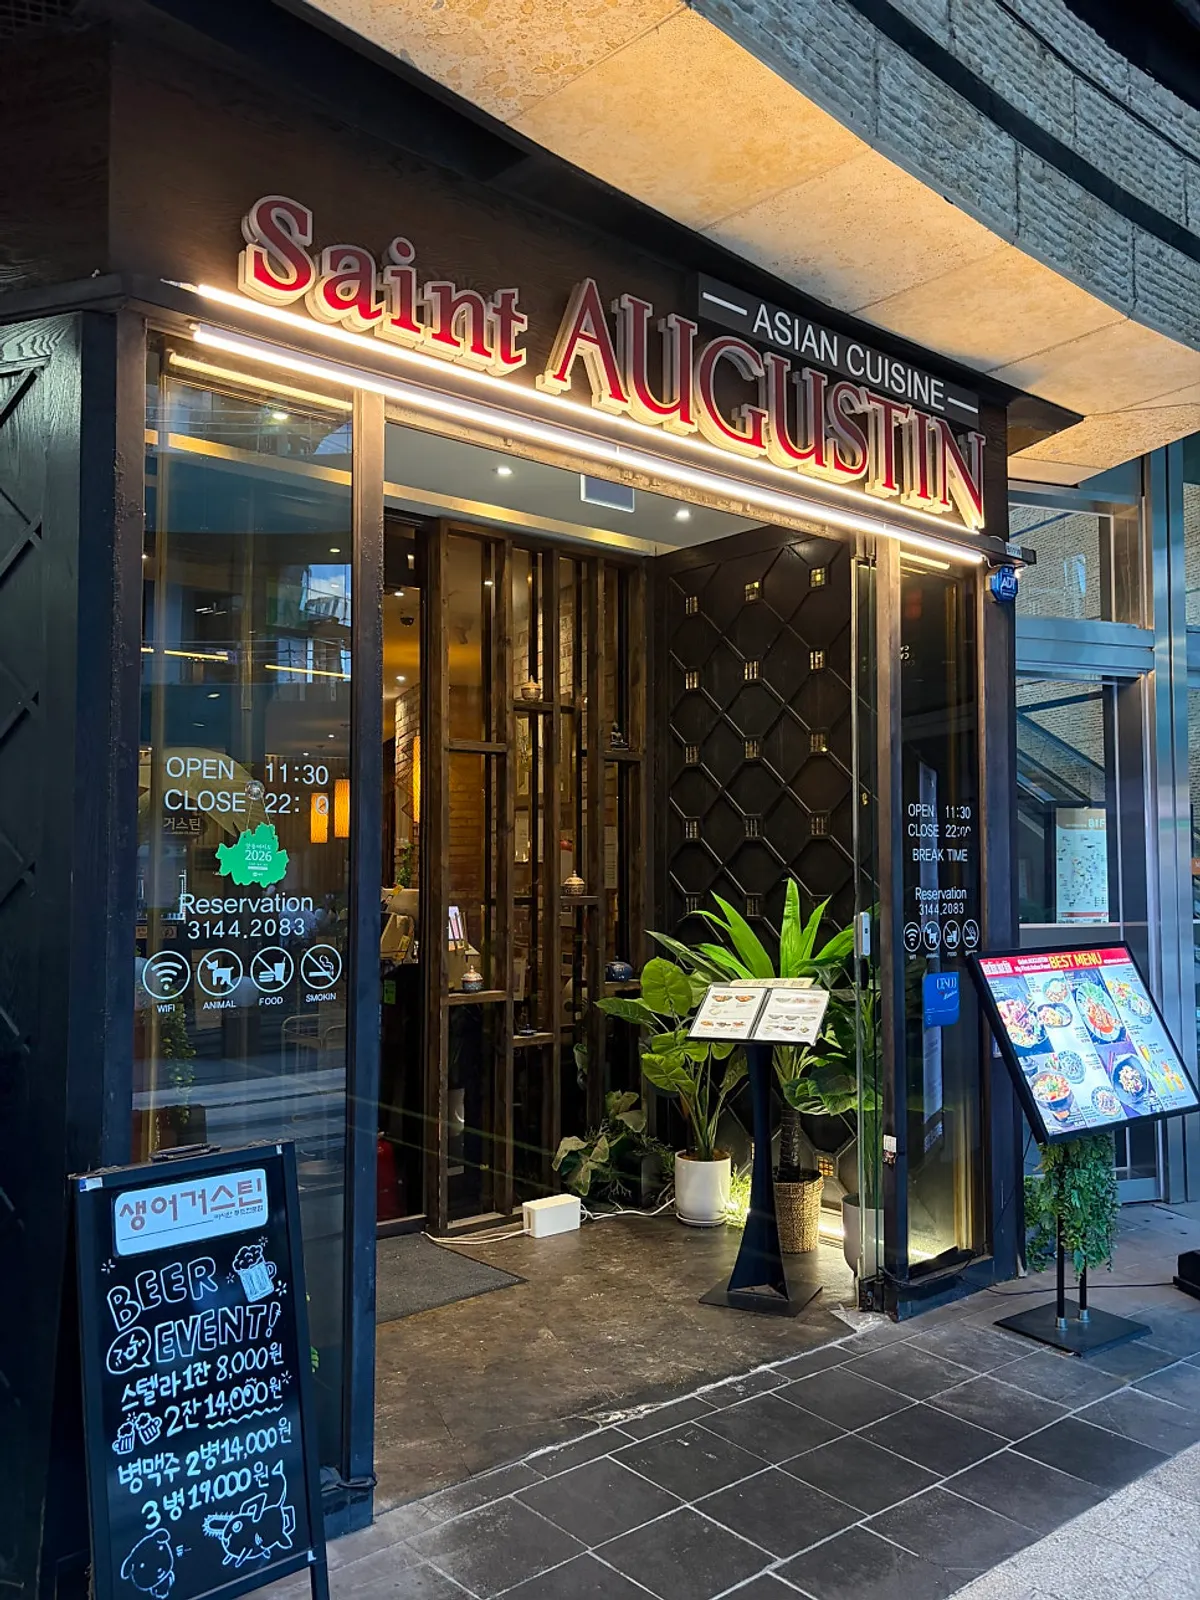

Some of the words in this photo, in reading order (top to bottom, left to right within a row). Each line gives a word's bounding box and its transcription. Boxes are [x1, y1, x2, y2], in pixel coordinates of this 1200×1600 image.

[238, 195, 528, 377] Saint
[536, 277, 986, 529] AUGUSTIN
[752, 303, 838, 367] ASIAN
[845, 343, 946, 411] CUISINE
[165, 756, 235, 781] OPEN
[265, 762, 329, 786] 11:30
[164, 788, 246, 813] CLOSE
[908, 803, 935, 818] OPEN
[945, 804, 972, 820] 11:30
[908, 823, 940, 838] CLOSE
[244, 849, 273, 862] 2026
[912, 848, 945, 862] BREAK
[946, 848, 969, 862] TIME
[179, 892, 314, 916] Reservation
[915, 886, 968, 901] Reservation
[919, 902, 965, 916] 3144.2083
[187, 917, 306, 940] 3144.2083
[1049, 953, 1075, 969] BEST
[1075, 951, 1103, 967] MENU
[157, 1003, 176, 1013] WIFI
[203, 1000, 237, 1010] ANIMAL
[258, 996, 284, 1006] FOOD
[119, 1177, 264, 1231] 생어거스틴
[106, 1256, 219, 1332] BEER
[154, 1301, 282, 1364] EVENT!
[216, 1342, 285, 1382] 8,000원
[164, 1400, 203, 1438] 2잔
[117, 1451, 181, 1494] 병맥주
